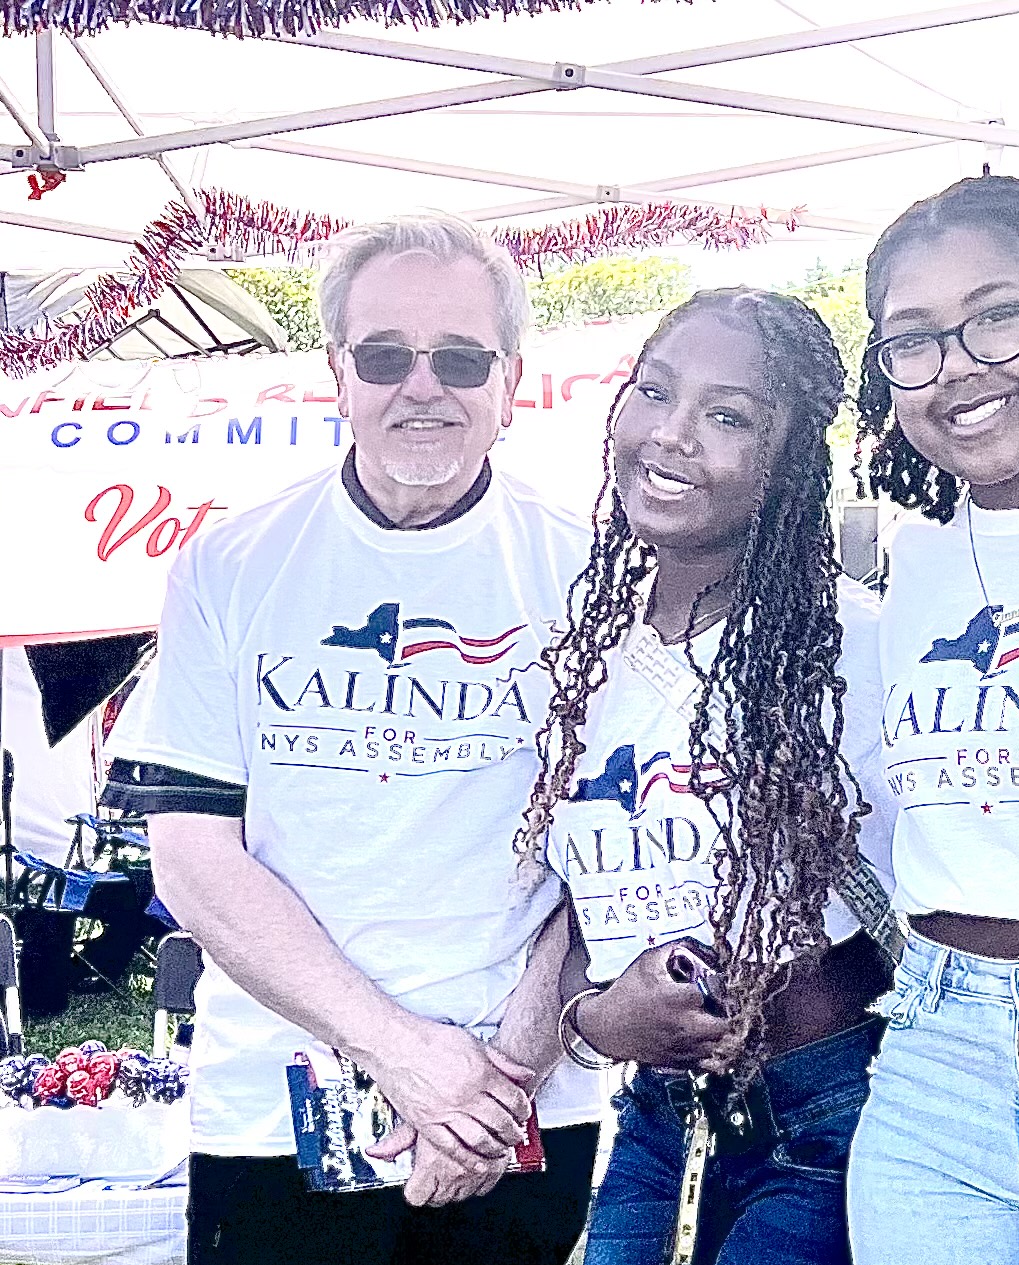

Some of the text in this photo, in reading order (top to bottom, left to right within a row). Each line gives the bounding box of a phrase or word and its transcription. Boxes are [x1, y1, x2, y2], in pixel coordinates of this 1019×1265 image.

[84, 484, 228, 562] Vot
[257, 653, 532, 724] KALINDA
[261, 733, 515, 764] NYS ASSEMBLY
[365, 726, 416, 744] FOR
[956, 748, 1011, 766] FOR
[566, 815, 735, 876] ALINDA
[619, 883, 663, 902] FOR
